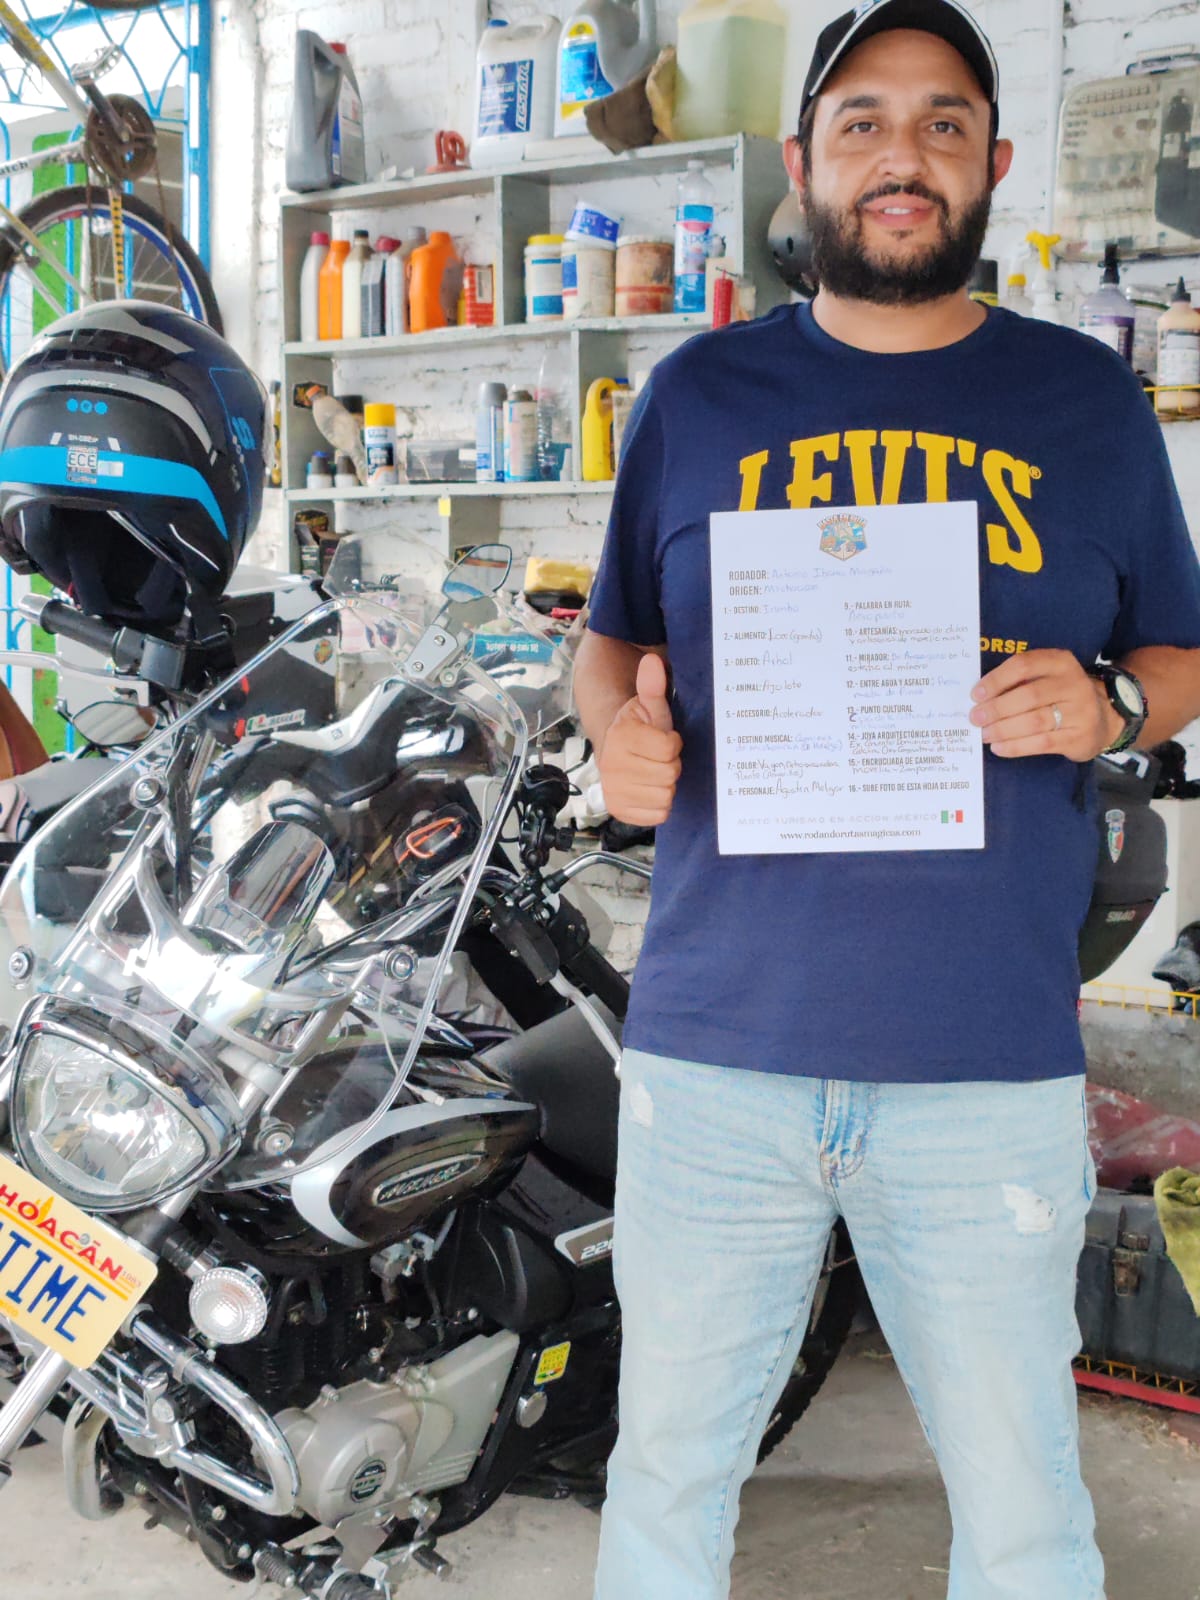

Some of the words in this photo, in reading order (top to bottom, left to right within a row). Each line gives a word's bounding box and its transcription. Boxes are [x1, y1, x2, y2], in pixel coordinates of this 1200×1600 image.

[69, 452, 97, 468] ECE
[729, 569, 769, 581] RODADOR:
[729, 585, 763, 597] ORIGEN:
[856, 600, 883, 610] PALABRA
[885, 600, 894, 609] EN
[734, 631, 767, 641] ALIMENTO:
[735, 656, 761, 667] OBJETO:
[859, 652, 891, 662] MIRADOR:
[736, 682, 762, 692] ANIMAL:
[859, 679, 880, 688] ENTRE
[881, 679, 898, 687] AGUA
[904, 677, 930, 686] ASFALTO
[736, 708, 772, 718] ACCESORIO:
[860, 704, 881, 714] PUNTO
[883, 703, 914, 713] CULTURAL
[737, 735, 763, 744] DESTINO
[765, 733, 793, 743] MUSICAL:
[862, 731, 877, 740] JOYA
[931, 729, 943, 738] DEL
[862, 756, 904, 766] ENCRUCIJADA
[905, 756, 914, 765] DE
[738, 785, 776, 797] PERSONAJE:
[862, 783, 879, 793] SUBE
[880, 783, 896, 792] FOTO
[897, 782, 905, 791] DE
[906, 782, 922, 791] ESTA
[923, 781, 940, 790] HOJA
[941, 780, 951, 790] DE
[952, 779, 971, 789] JUEGO
[0, 1222, 107, 1343] TIME
